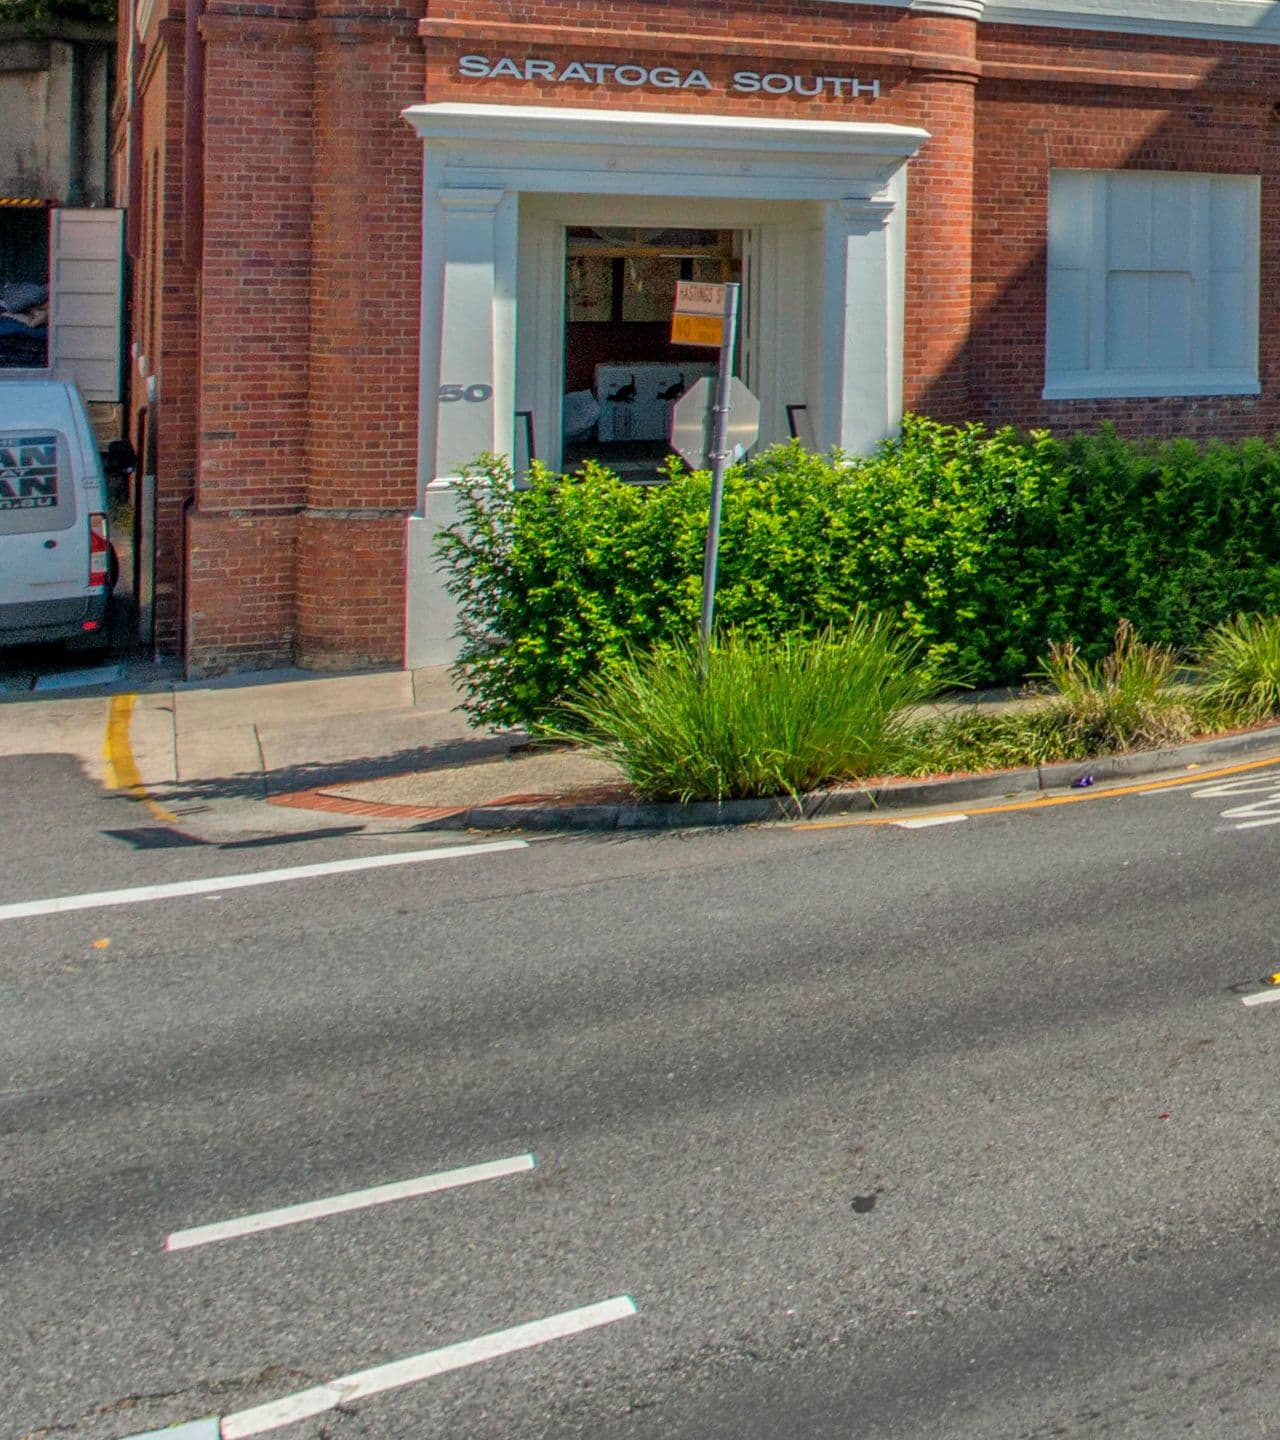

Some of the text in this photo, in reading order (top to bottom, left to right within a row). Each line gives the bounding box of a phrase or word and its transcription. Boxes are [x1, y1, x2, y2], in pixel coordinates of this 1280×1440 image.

[458, 55, 880, 98] SARATOGA SOUTH
[439, 383, 493, 402] 50
